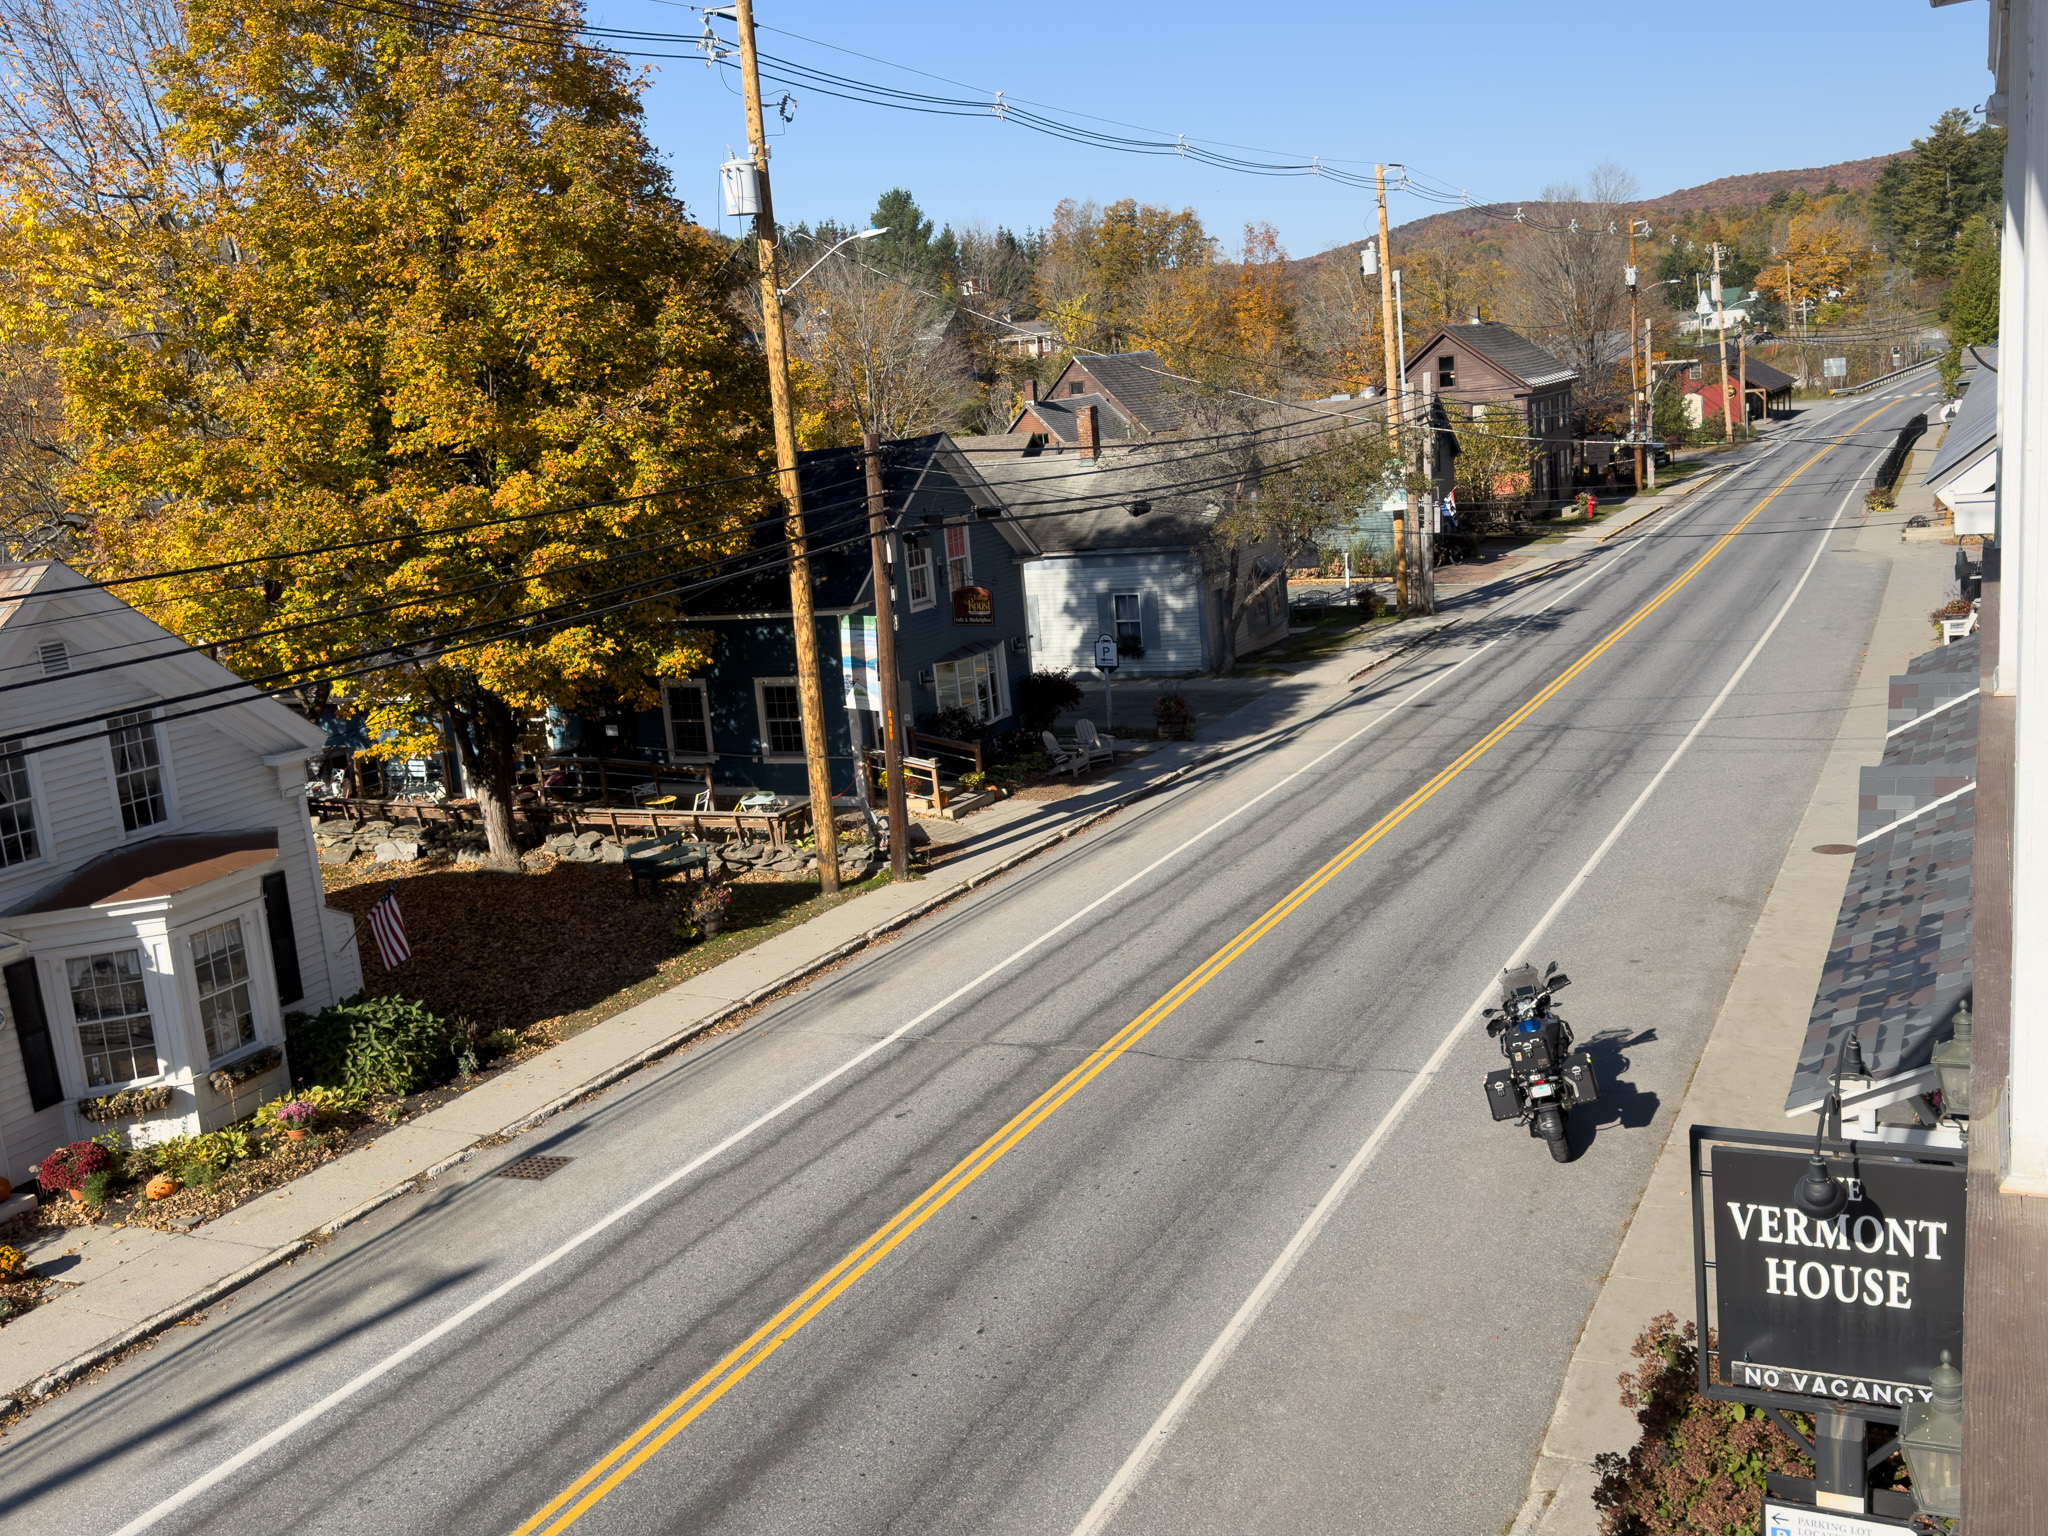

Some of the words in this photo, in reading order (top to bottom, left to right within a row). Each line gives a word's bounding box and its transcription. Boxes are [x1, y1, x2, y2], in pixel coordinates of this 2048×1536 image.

[1102, 646, 1110, 656] P
[1727, 1201, 1948, 1261] VERMONT
[1765, 1257, 1912, 1310] HOUSE
[1744, 1366, 1780, 1388] NO
[1791, 1372, 1934, 1404] VACANCY
[1798, 1517, 1847, 1533] PARKING
[1850, 1525, 1873, 1536] LOT
